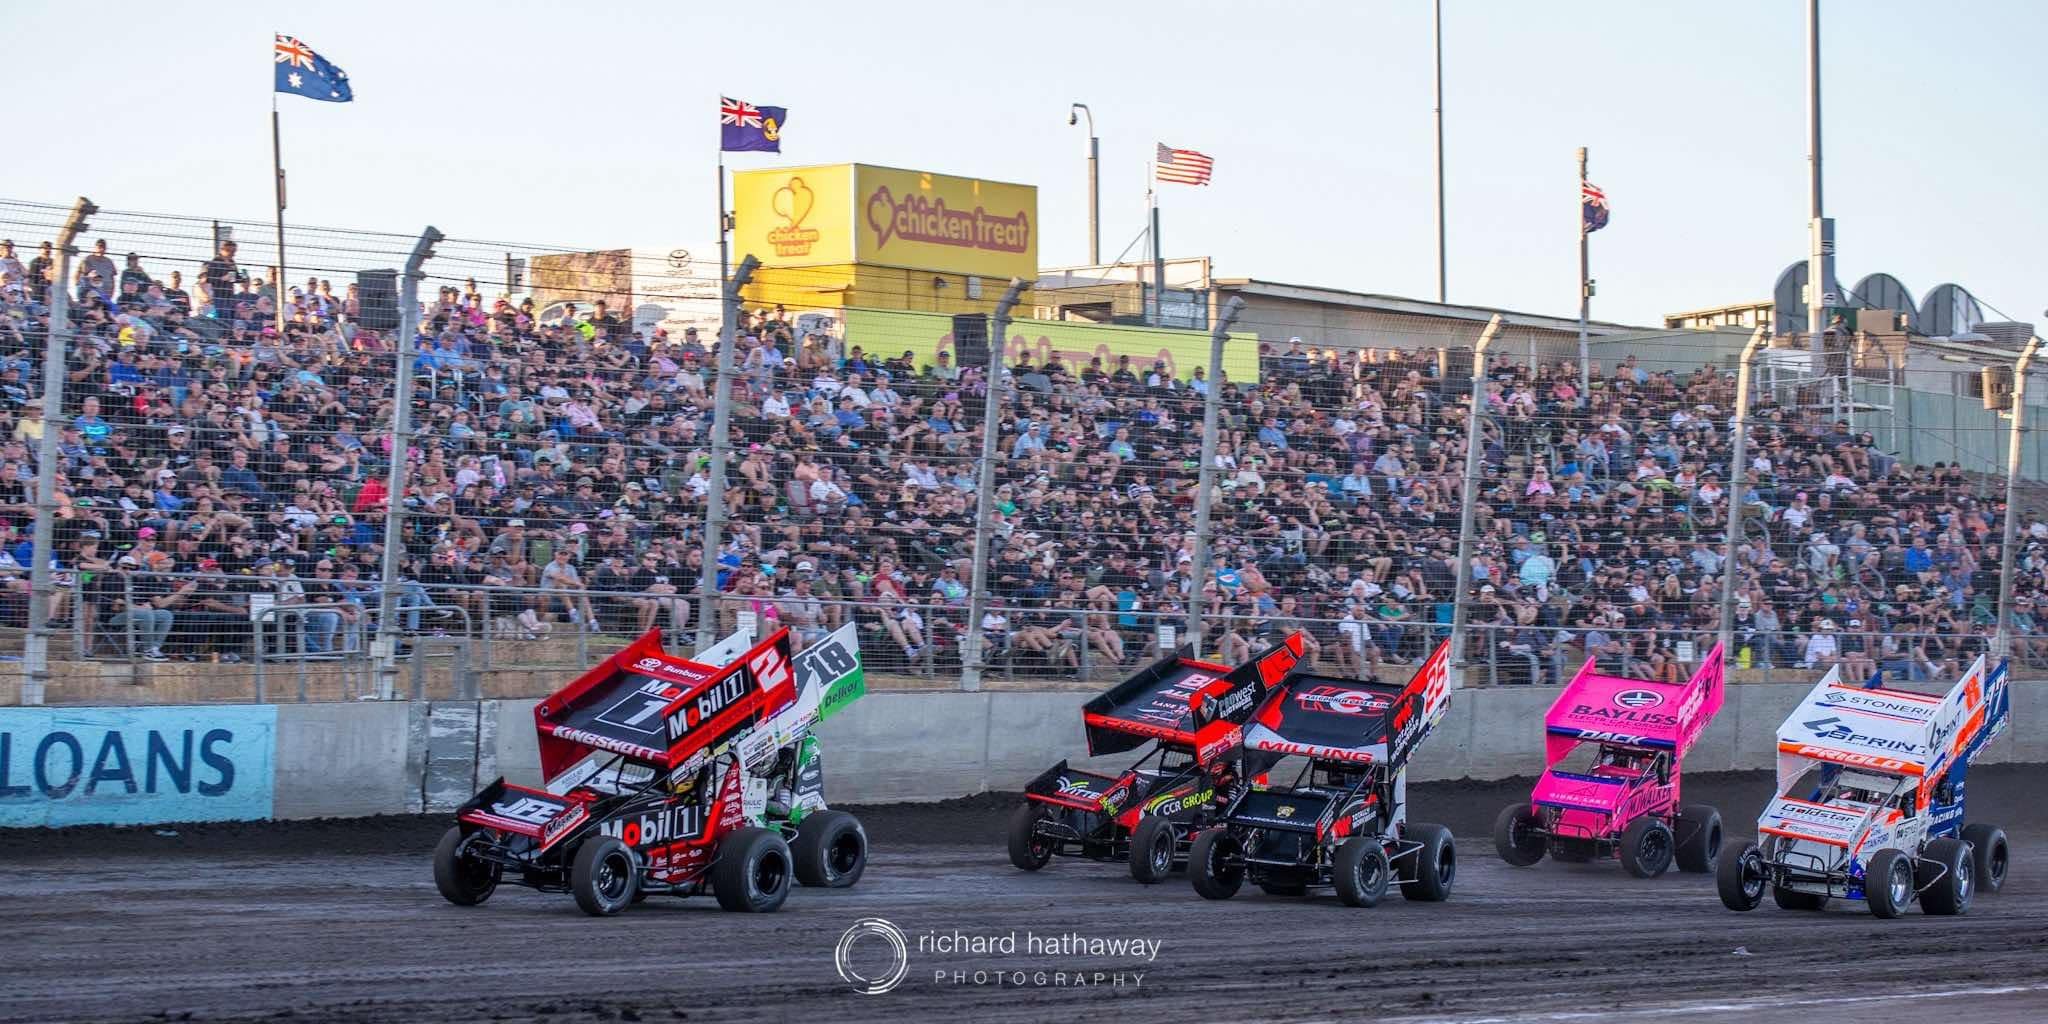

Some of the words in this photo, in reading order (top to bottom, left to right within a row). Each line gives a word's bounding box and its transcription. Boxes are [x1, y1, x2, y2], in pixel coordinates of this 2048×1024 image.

[768, 227, 820, 243] chicken
[895, 198, 973, 240] chicken
[976, 210, 1027, 247] treat
[776, 241, 810, 256] treat
[751, 648, 788, 692] 2
[668, 680, 722, 740] Mobil
[1572, 704, 1678, 725] BAYLISS
[552, 725, 657, 760] KINGSHOTT
[1257, 740, 1374, 762] MILLING
[0, 729, 235, 797] LOANS
[1163, 801, 1182, 816] CCR
[1182, 788, 1213, 810] GROUP
[1781, 803, 1855, 822] Goldstar
[600, 808, 672, 847] Mobil
